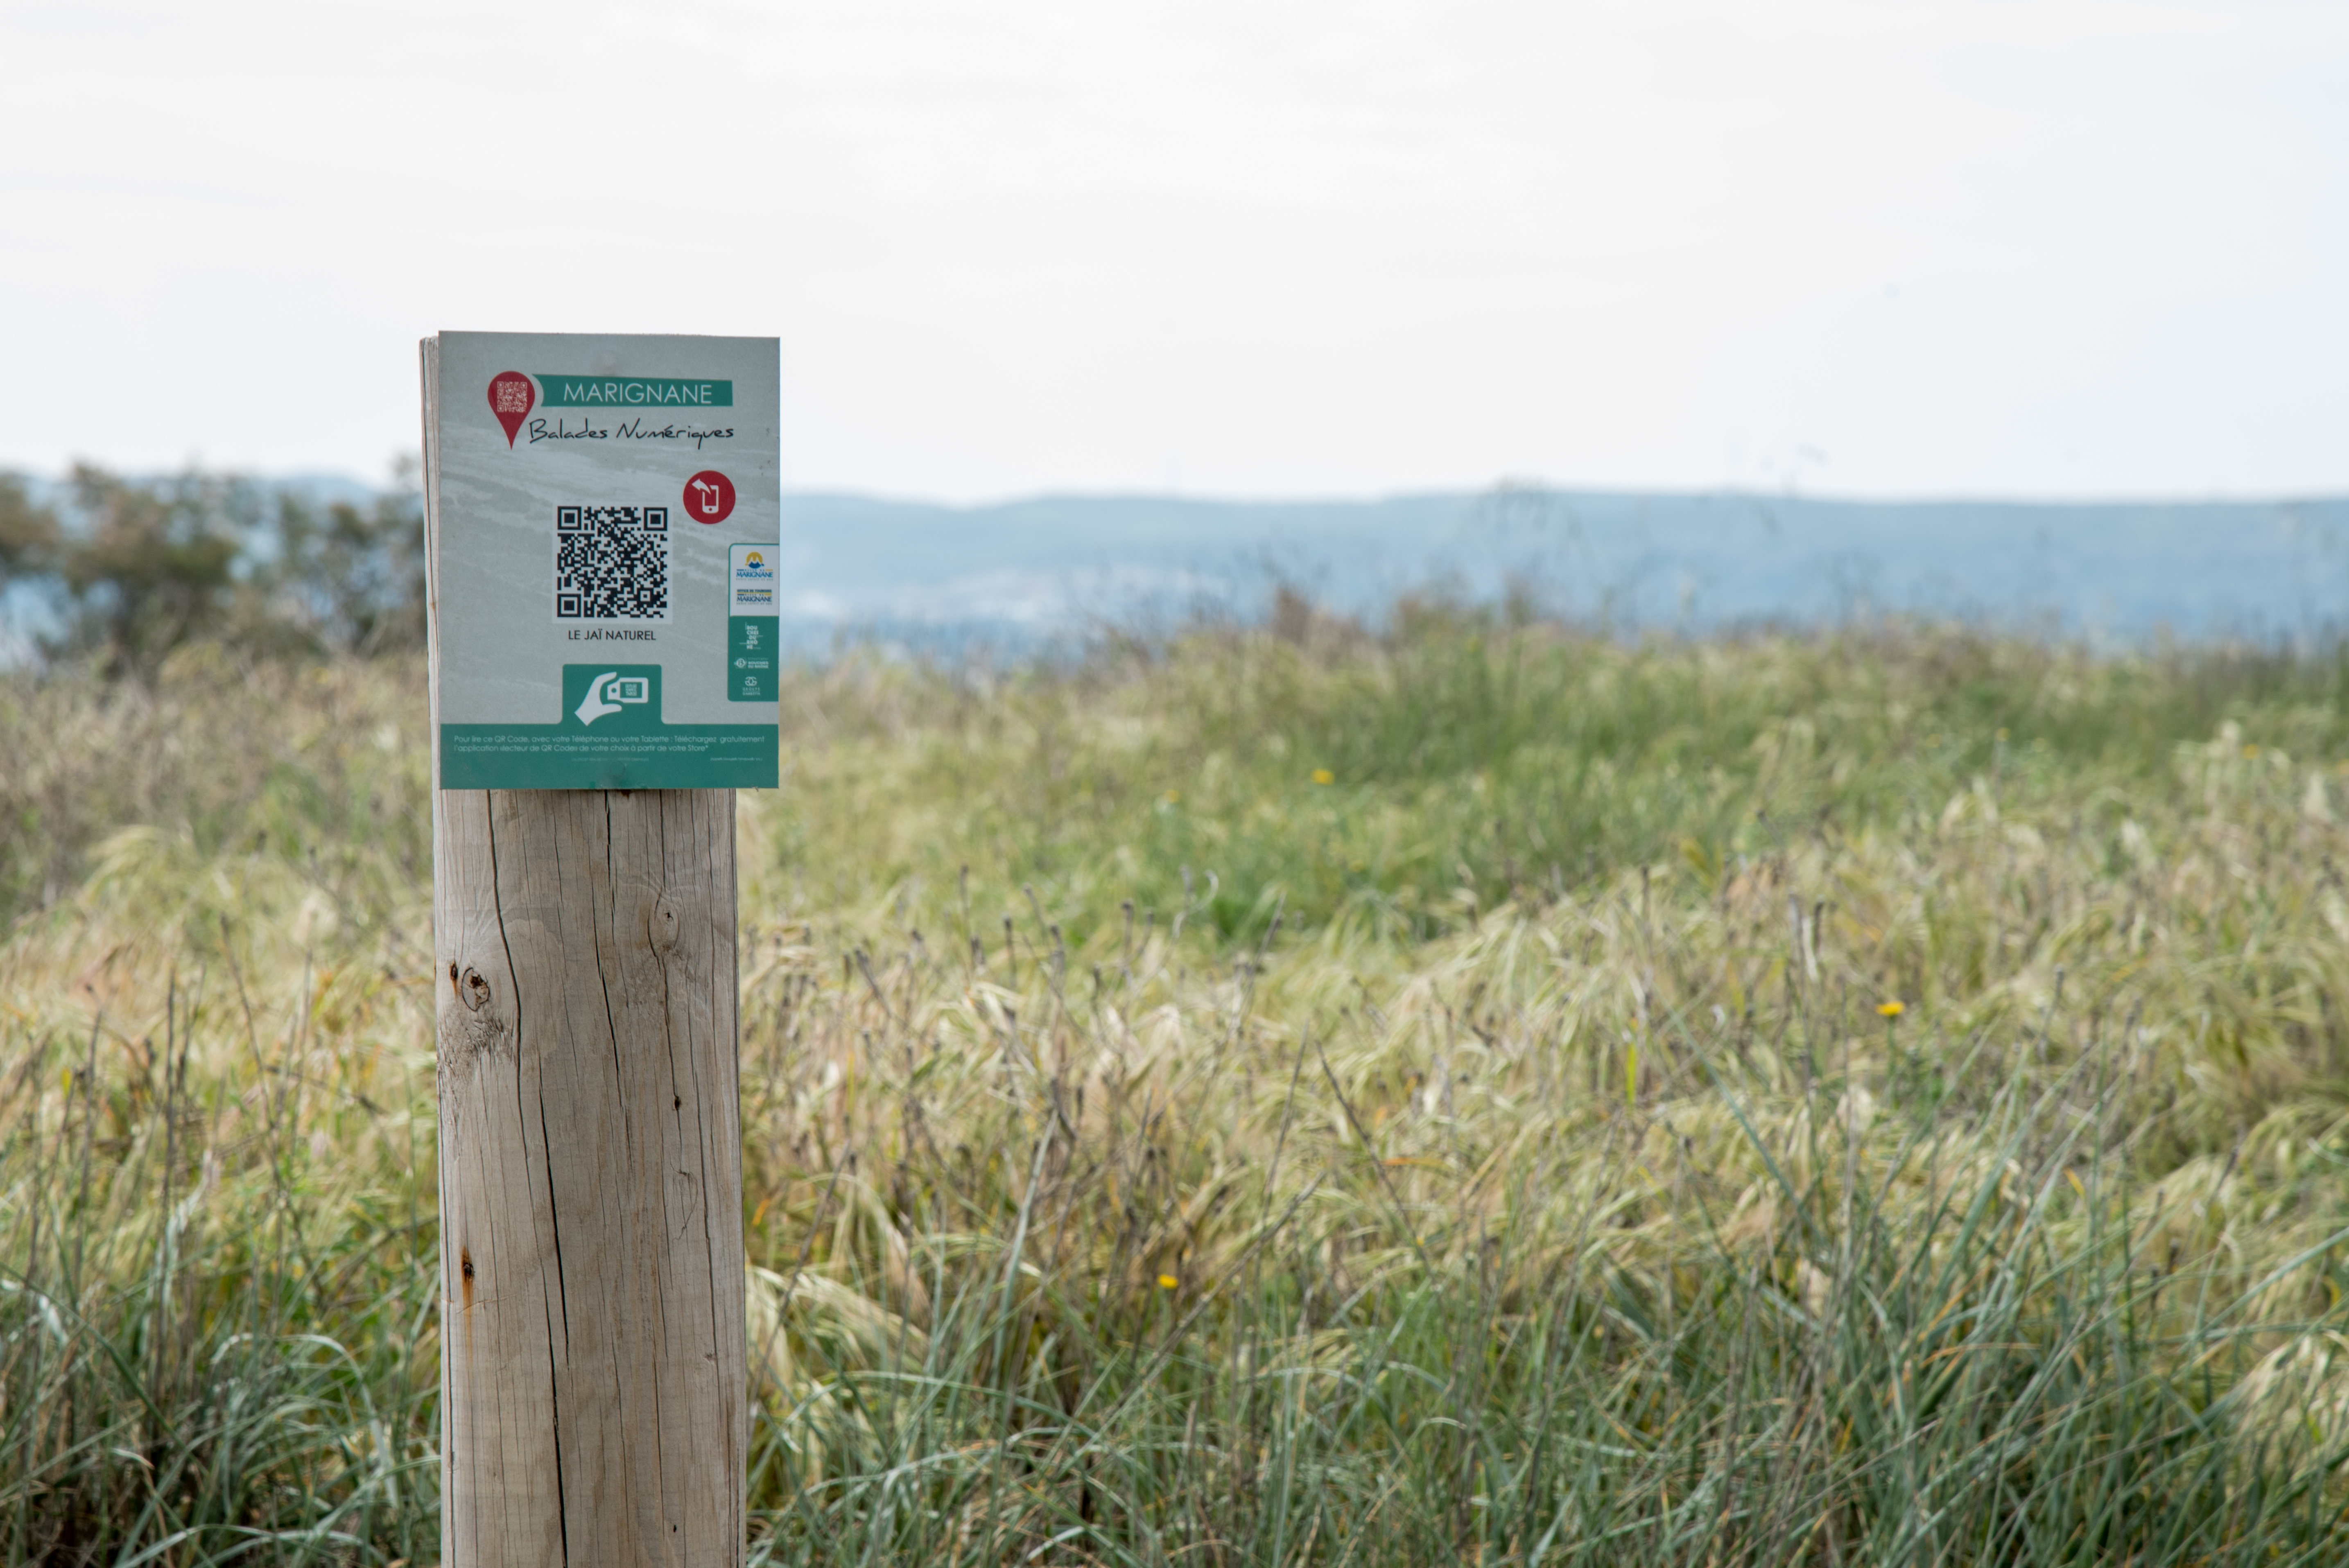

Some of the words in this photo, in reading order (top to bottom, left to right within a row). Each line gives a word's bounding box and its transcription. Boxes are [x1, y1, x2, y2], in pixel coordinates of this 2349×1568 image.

[563, 382, 712, 404] MARIGNANE
[529, 417, 608, 444] Balades
[616, 417, 734, 450] Numériques
[568, 630, 581, 640] LE
[584, 628, 603, 640] JAÏ
[606, 630, 656, 640] NATUREL
[571, 735, 609, 744] Téléphone
[674, 735, 717, 744] Téléchargez
[720, 735, 764, 744] gratuitement
[454, 744, 499, 752] l'application
[638, 744, 655, 752] partir
